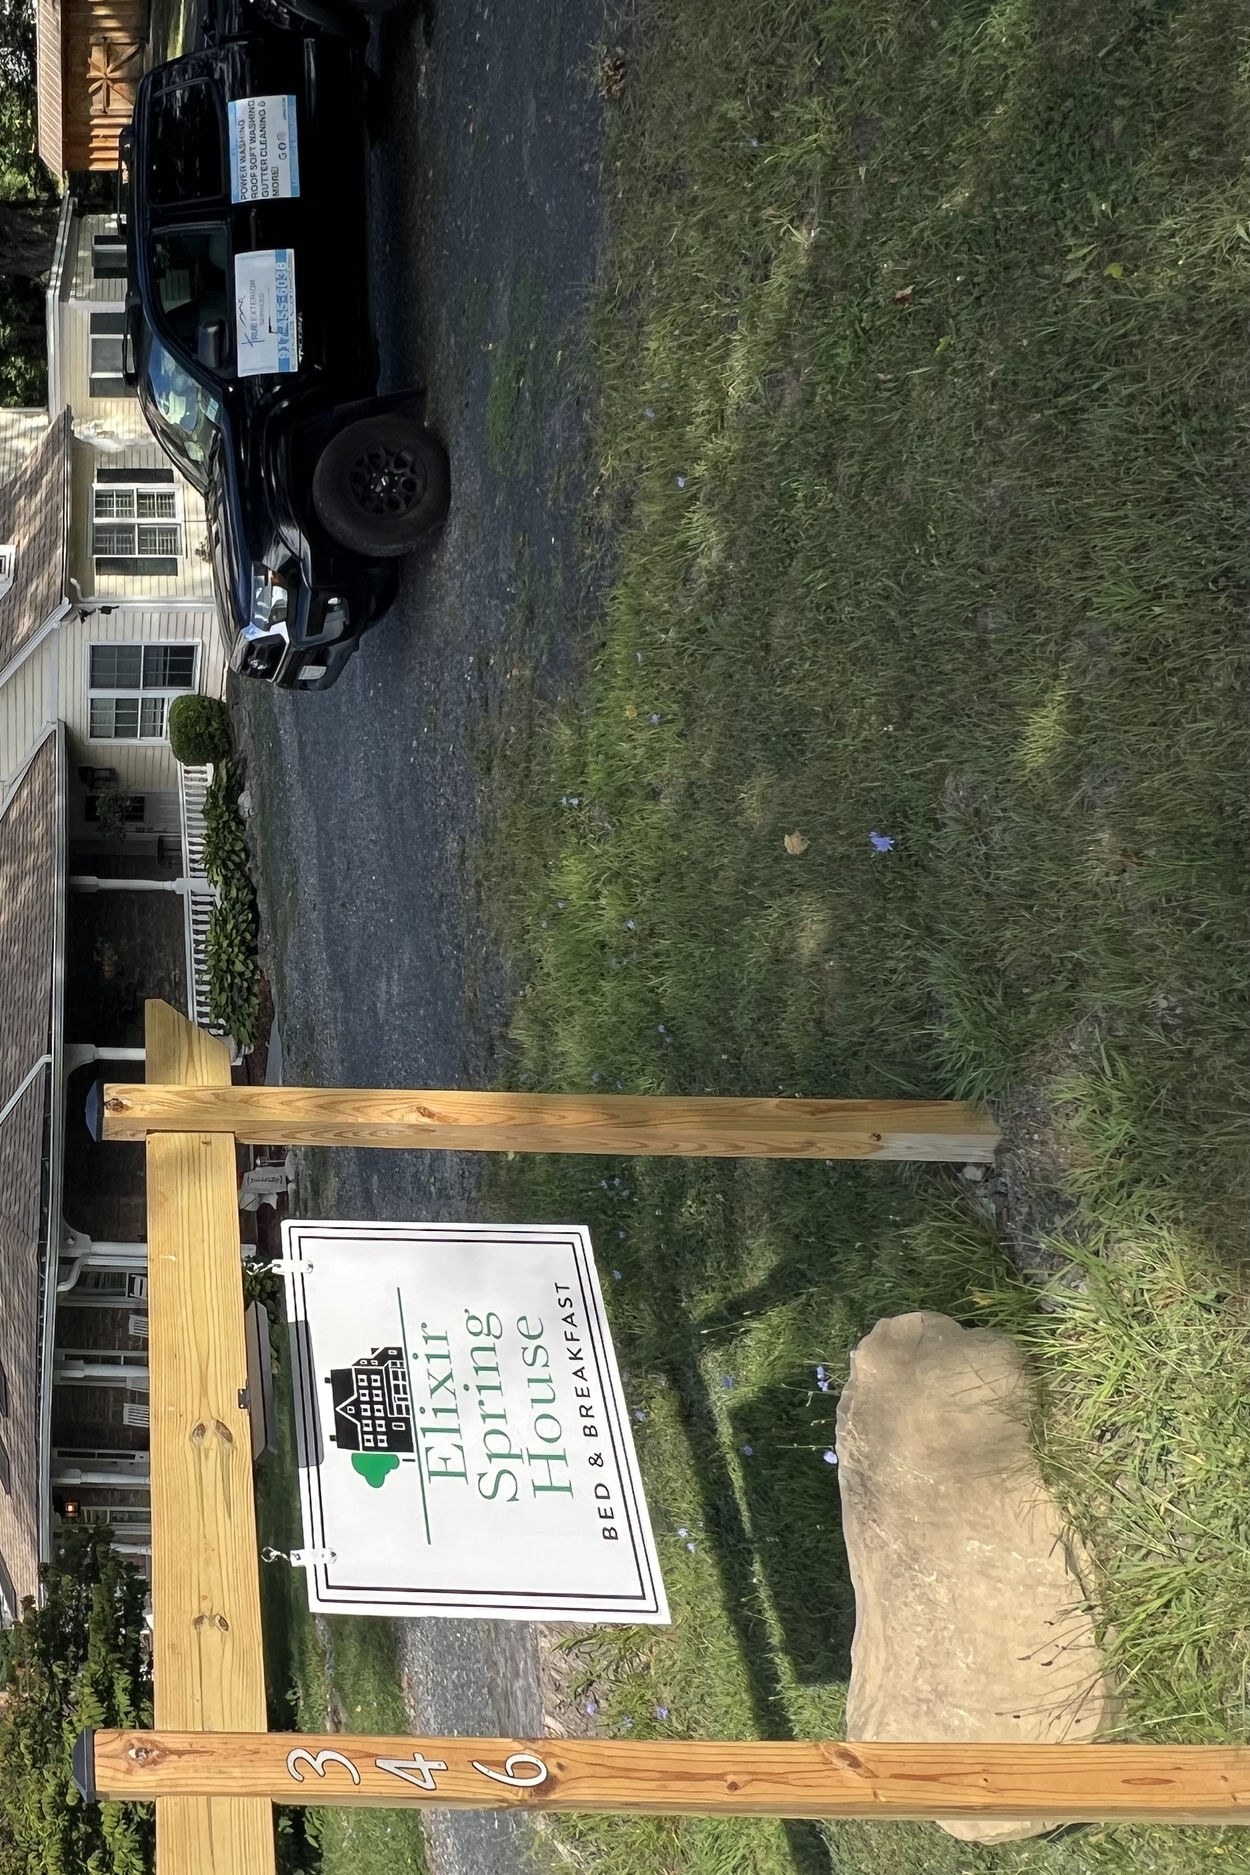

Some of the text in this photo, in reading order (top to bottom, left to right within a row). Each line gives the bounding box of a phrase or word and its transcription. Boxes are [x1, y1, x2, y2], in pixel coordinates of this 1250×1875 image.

[238, 119, 248, 200] POWER WASHING
[248, 100, 258, 199] ROOF SOFT WASHING
[258, 108, 268, 158] CLEANING
[260, 158, 270, 198] GUTTER
[250, 279, 258, 321] EXTERIOR
[412, 1322, 469, 1485] Elixir
[463, 1308, 524, 1502] Spring
[516, 1315, 574, 1499] House
[554, 1281, 619, 1541] BED & BREAKFAST
